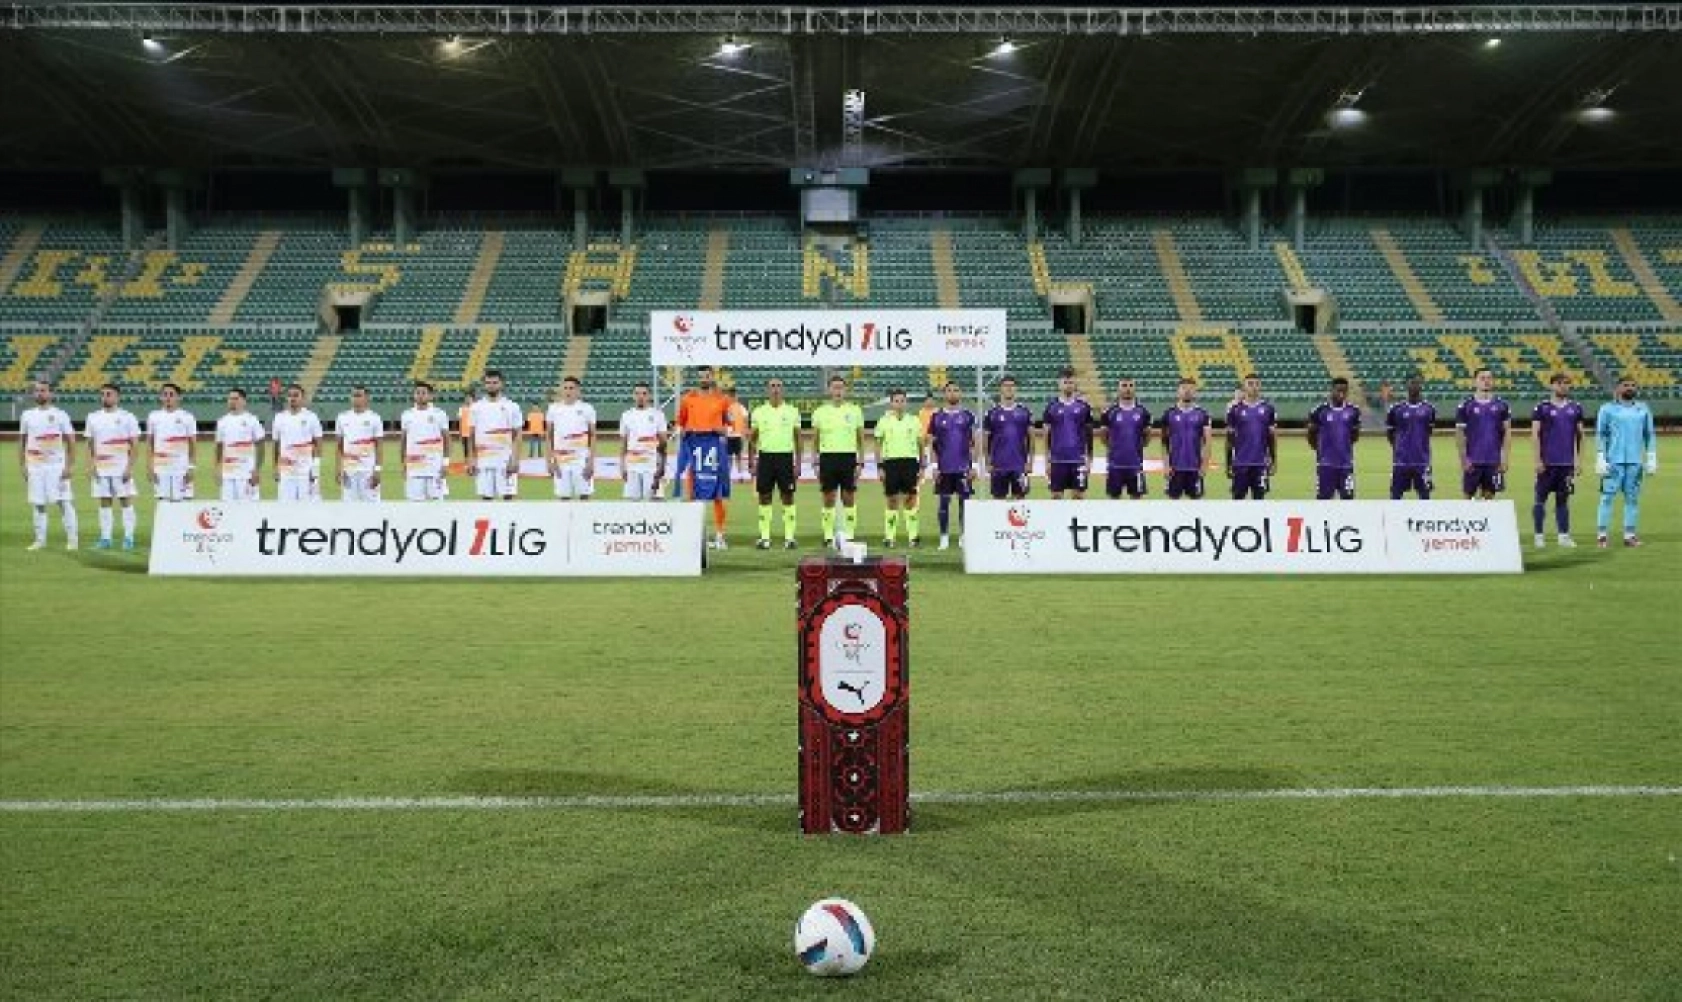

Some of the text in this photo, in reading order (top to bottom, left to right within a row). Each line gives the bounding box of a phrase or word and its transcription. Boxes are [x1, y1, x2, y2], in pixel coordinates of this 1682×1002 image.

[714, 323, 851, 357] trendyol
[692, 446, 720, 471] 14
[593, 518, 673, 537] trendyol
[1407, 517, 1490, 534] trendyol
[256, 518, 457, 563] trendyol
[1068, 517, 1272, 561] trendyol
[1421, 536, 1480, 553] yemek
